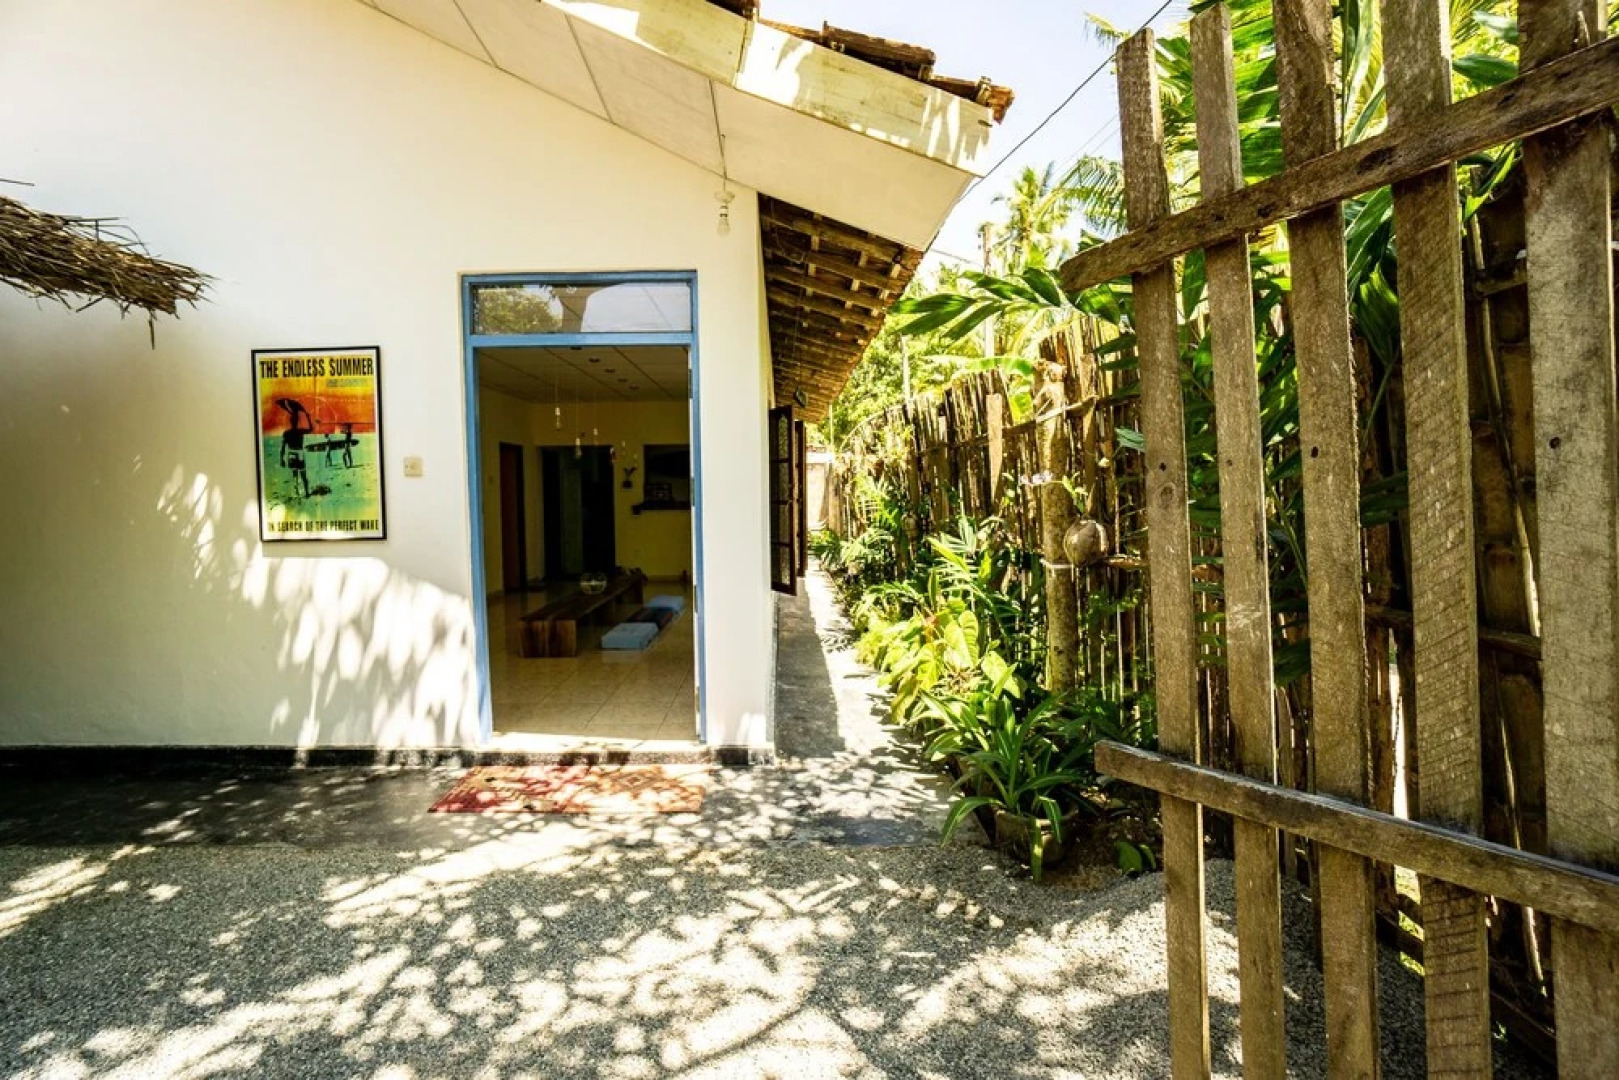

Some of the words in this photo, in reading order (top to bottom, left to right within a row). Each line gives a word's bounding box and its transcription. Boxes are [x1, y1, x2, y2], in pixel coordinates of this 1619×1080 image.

[260, 361, 278, 378] THE
[282, 359, 325, 377] ENDLESS
[329, 358, 374, 376] SUMMER
